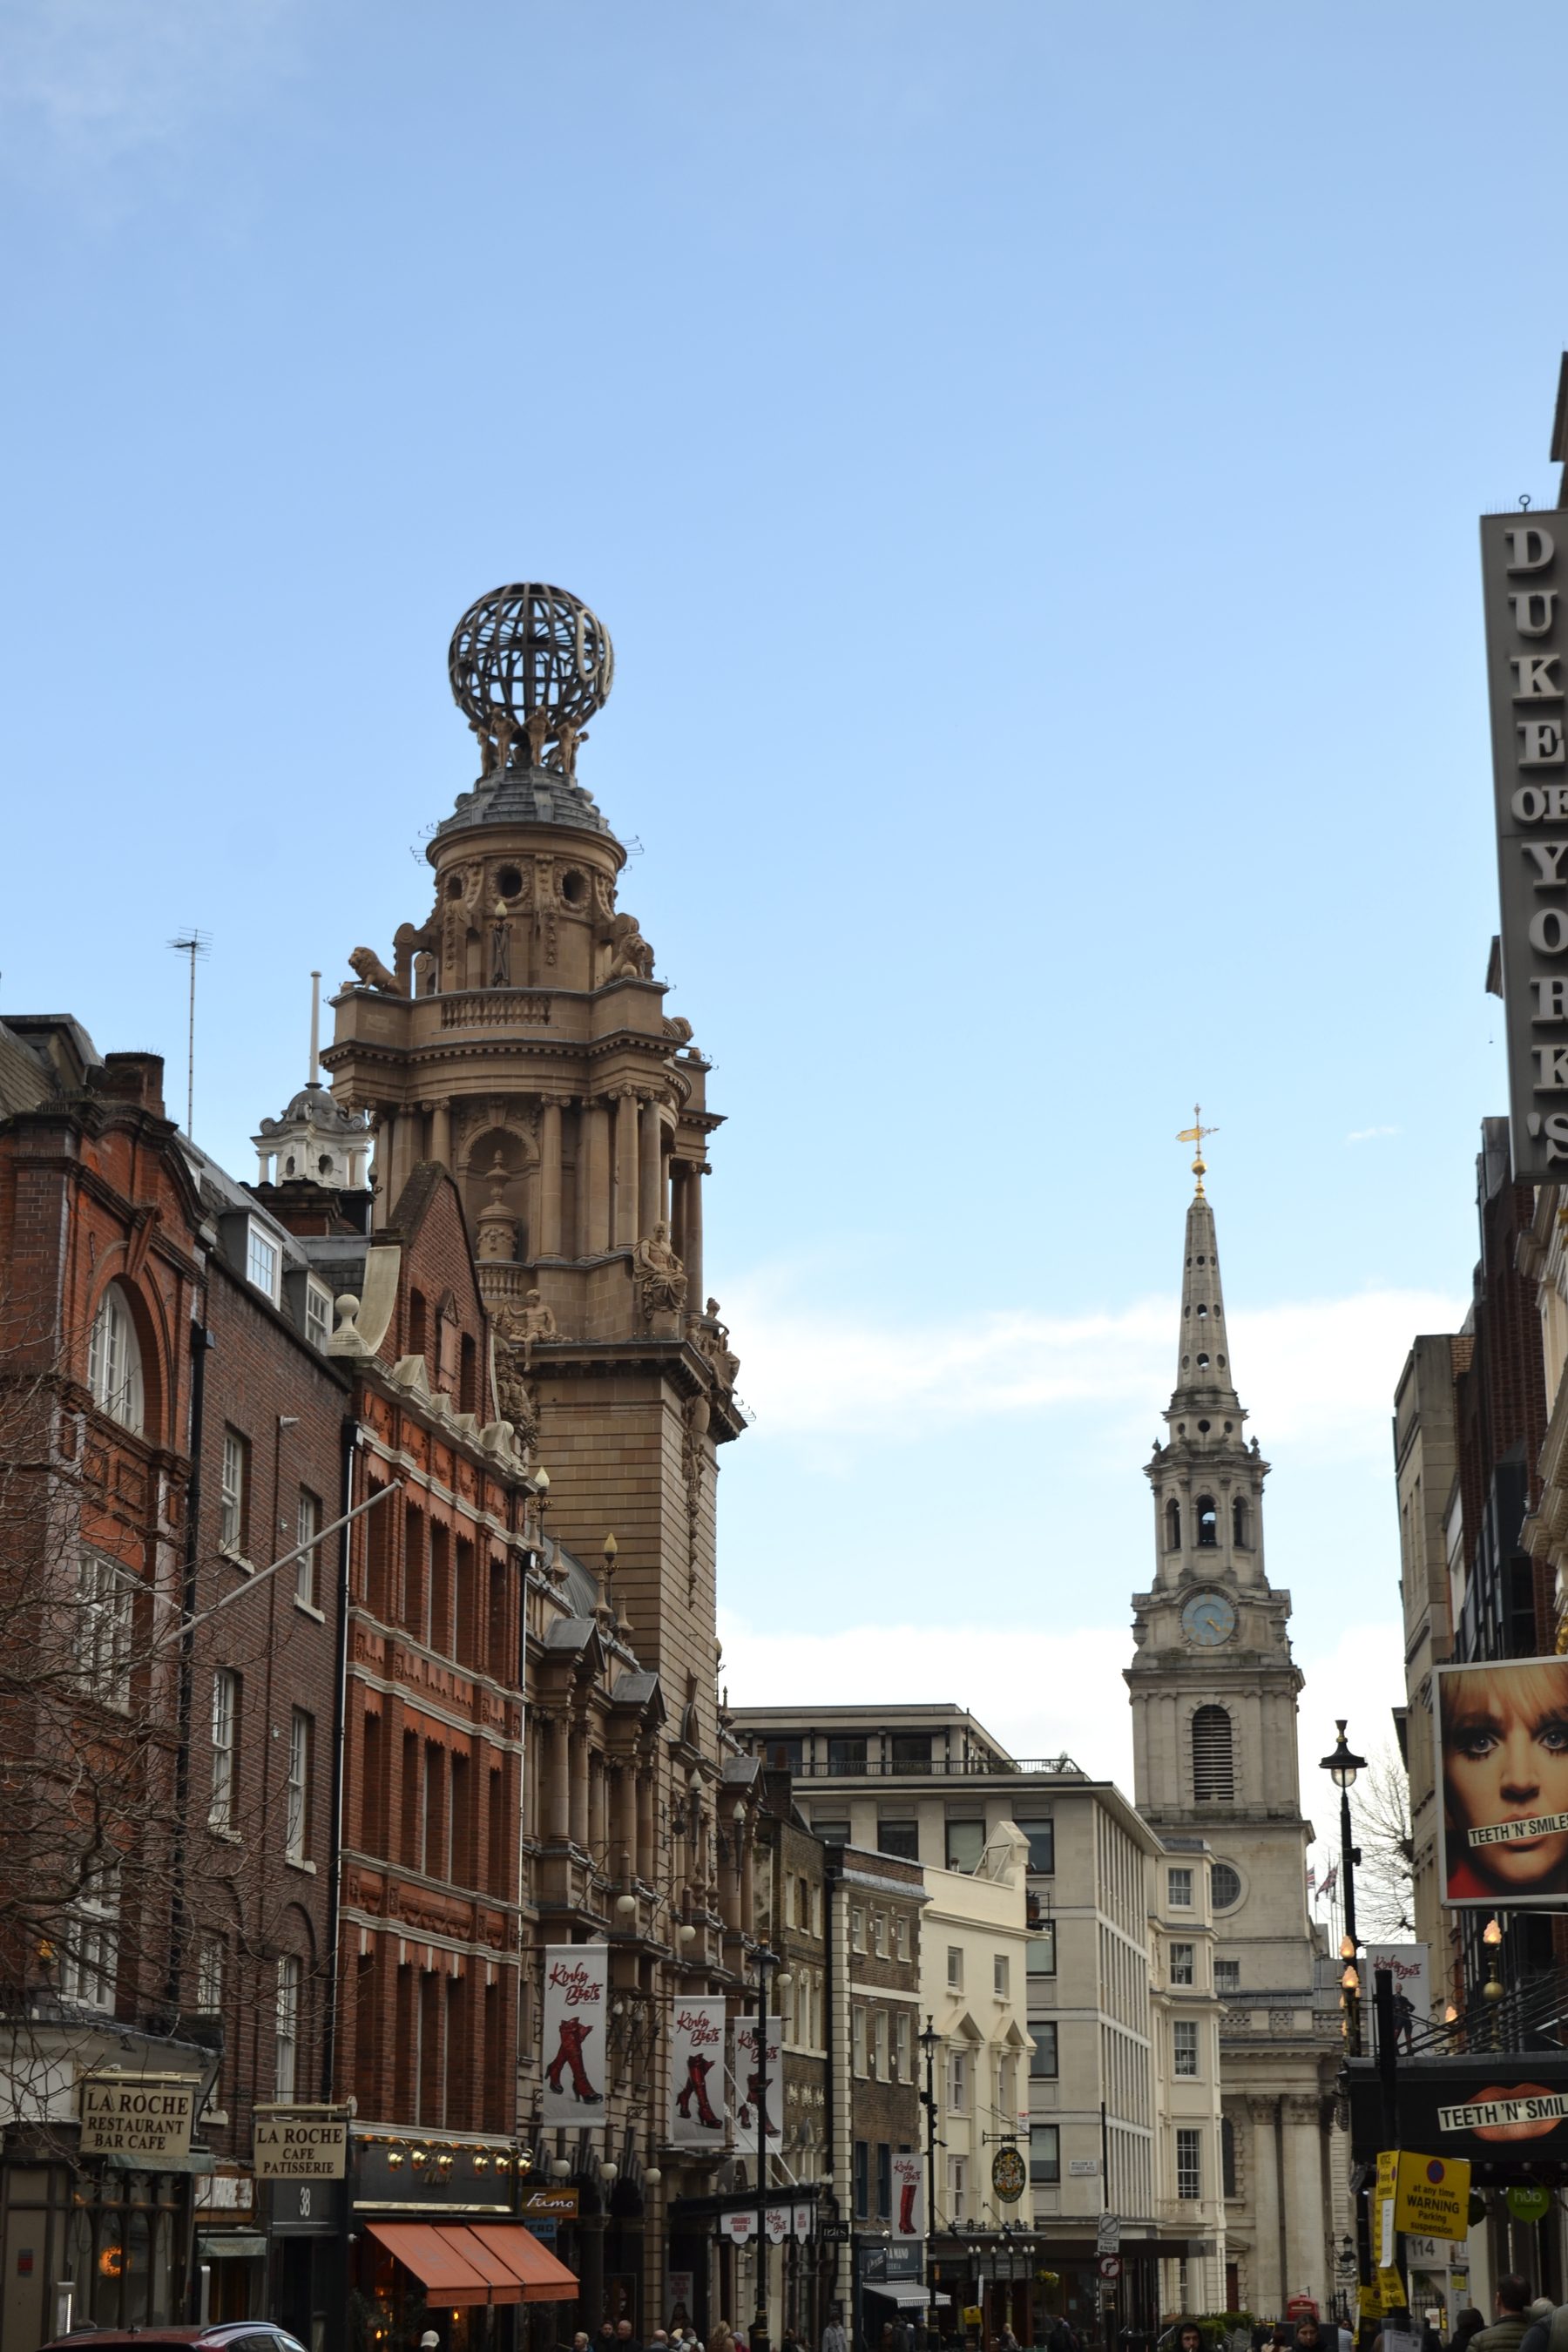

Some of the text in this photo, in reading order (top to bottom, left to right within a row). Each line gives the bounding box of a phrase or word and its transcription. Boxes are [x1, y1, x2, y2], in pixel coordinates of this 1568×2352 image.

[1504, 526, 1565, 768] DUKE
[1470, 1825, 1509, 1844] TEETH
[549, 1962, 590, 1990] Kinky
[564, 1983, 604, 2006] Boots
[676, 2010, 710, 2033] Kinky
[690, 2027, 722, 2047] Boots
[87, 2092, 189, 2115] LA ROCHE
[87, 2116, 185, 2134] RESTAURANT
[1440, 2105, 1498, 2128] TEETH
[94, 2132, 166, 2150] BAR CAFE
[257, 2128, 343, 2144] LA ROCHE
[282, 2148, 314, 2159] CAFE
[263, 2161, 335, 2173] PATISSERIE
[1413, 2184, 1456, 2198] at any time
[1514, 2189, 1542, 2203] hub
[299, 2186, 311, 2217] 38
[527, 2193, 574, 2208] Fumo
[1407, 2195, 1460, 2214] WARNING
[1418, 2210, 1447, 2224] Parking
[1410, 2220, 1453, 2234] suspension
[1411, 2239, 1436, 2257] 114
